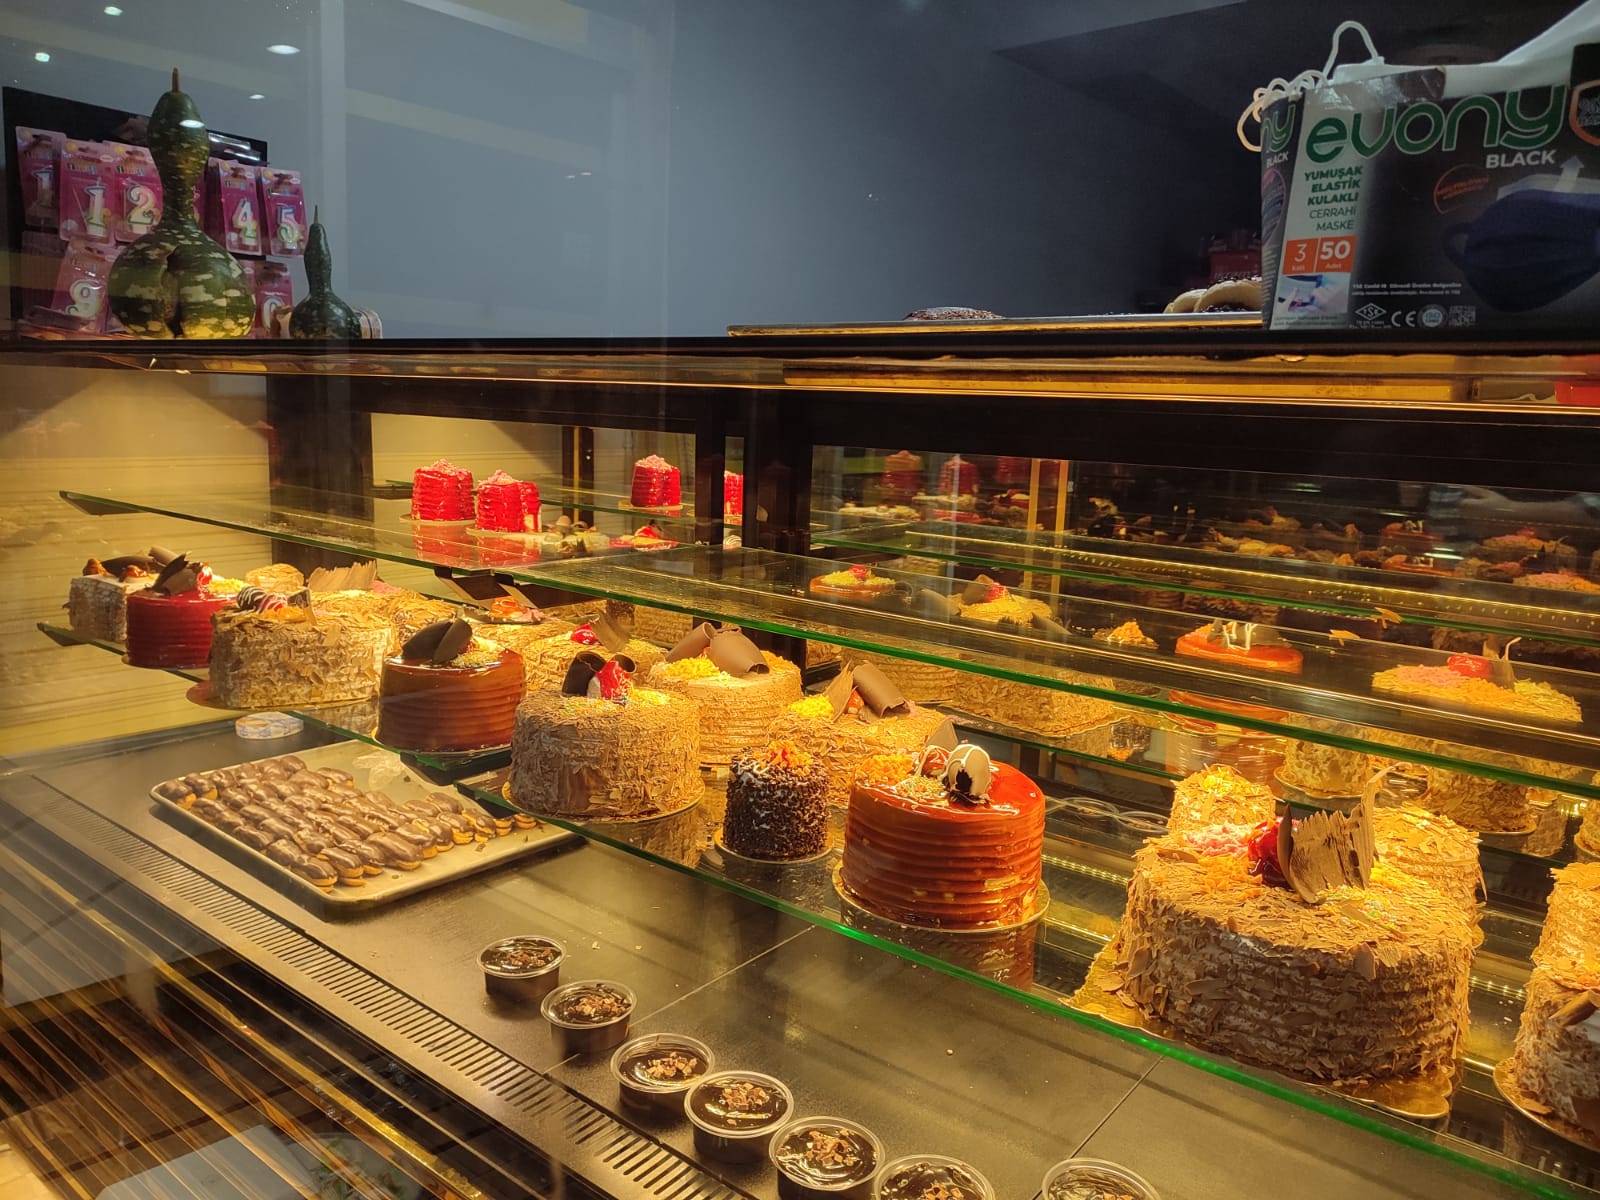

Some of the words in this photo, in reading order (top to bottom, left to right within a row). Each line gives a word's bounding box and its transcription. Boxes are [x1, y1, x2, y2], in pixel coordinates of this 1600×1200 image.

[1305, 85, 1567, 164] evony
[1266, 152, 1289, 169] BLACK
[1485, 150, 1556, 169] BLACK
[1304, 166, 1363, 181] YUMUŞAK
[1311, 179, 1361, 192] ELASTİK
[127, 184, 157, 229] 2
[1306, 192, 1360, 206] KULAKLI
[232, 199, 258, 243] 4
[276, 206, 299, 246] 5
[1315, 219, 1355, 231] MASKE
[1294, 243, 1307, 263] 3
[1319, 240, 1351, 260] 50
[1391, 310, 1416, 328] CE
